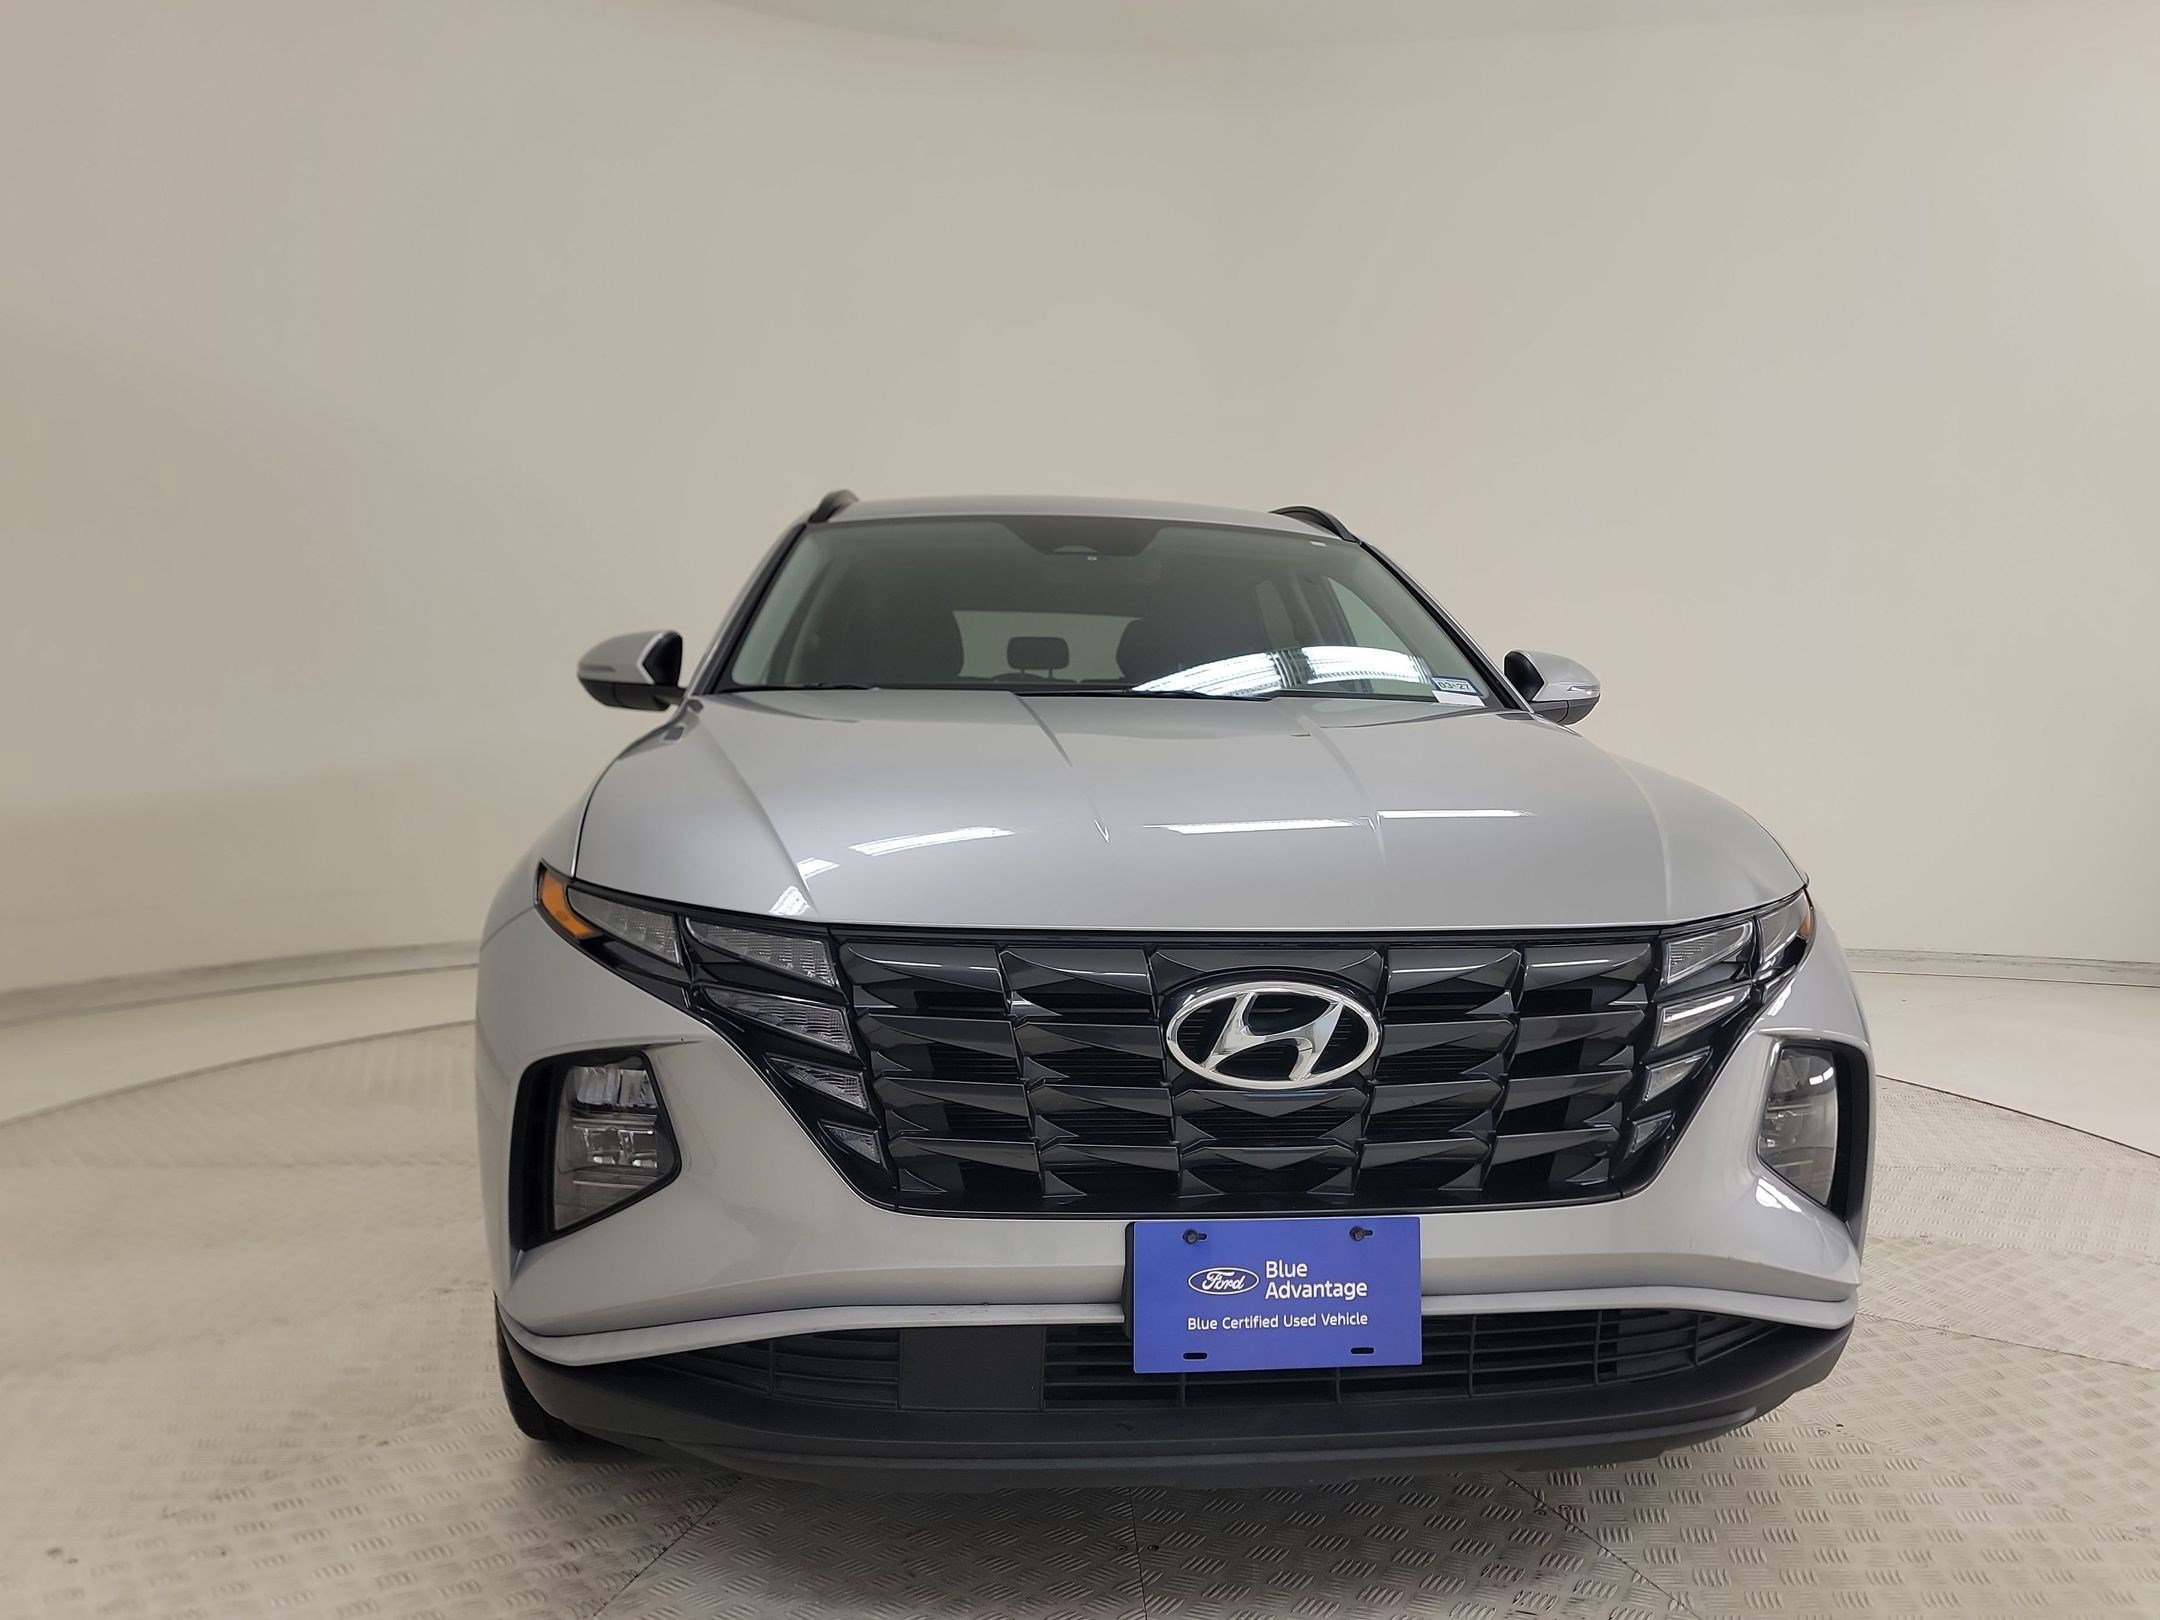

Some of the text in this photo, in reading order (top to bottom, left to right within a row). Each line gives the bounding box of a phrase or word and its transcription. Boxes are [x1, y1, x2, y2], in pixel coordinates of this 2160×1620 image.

[1265, 1260, 1308, 1278] Blue
[1202, 1270, 1246, 1291] Ford
[1265, 1280, 1368, 1300] Advantage
[1187, 1312, 1368, 1330] Blue Certified Used Vehicle
